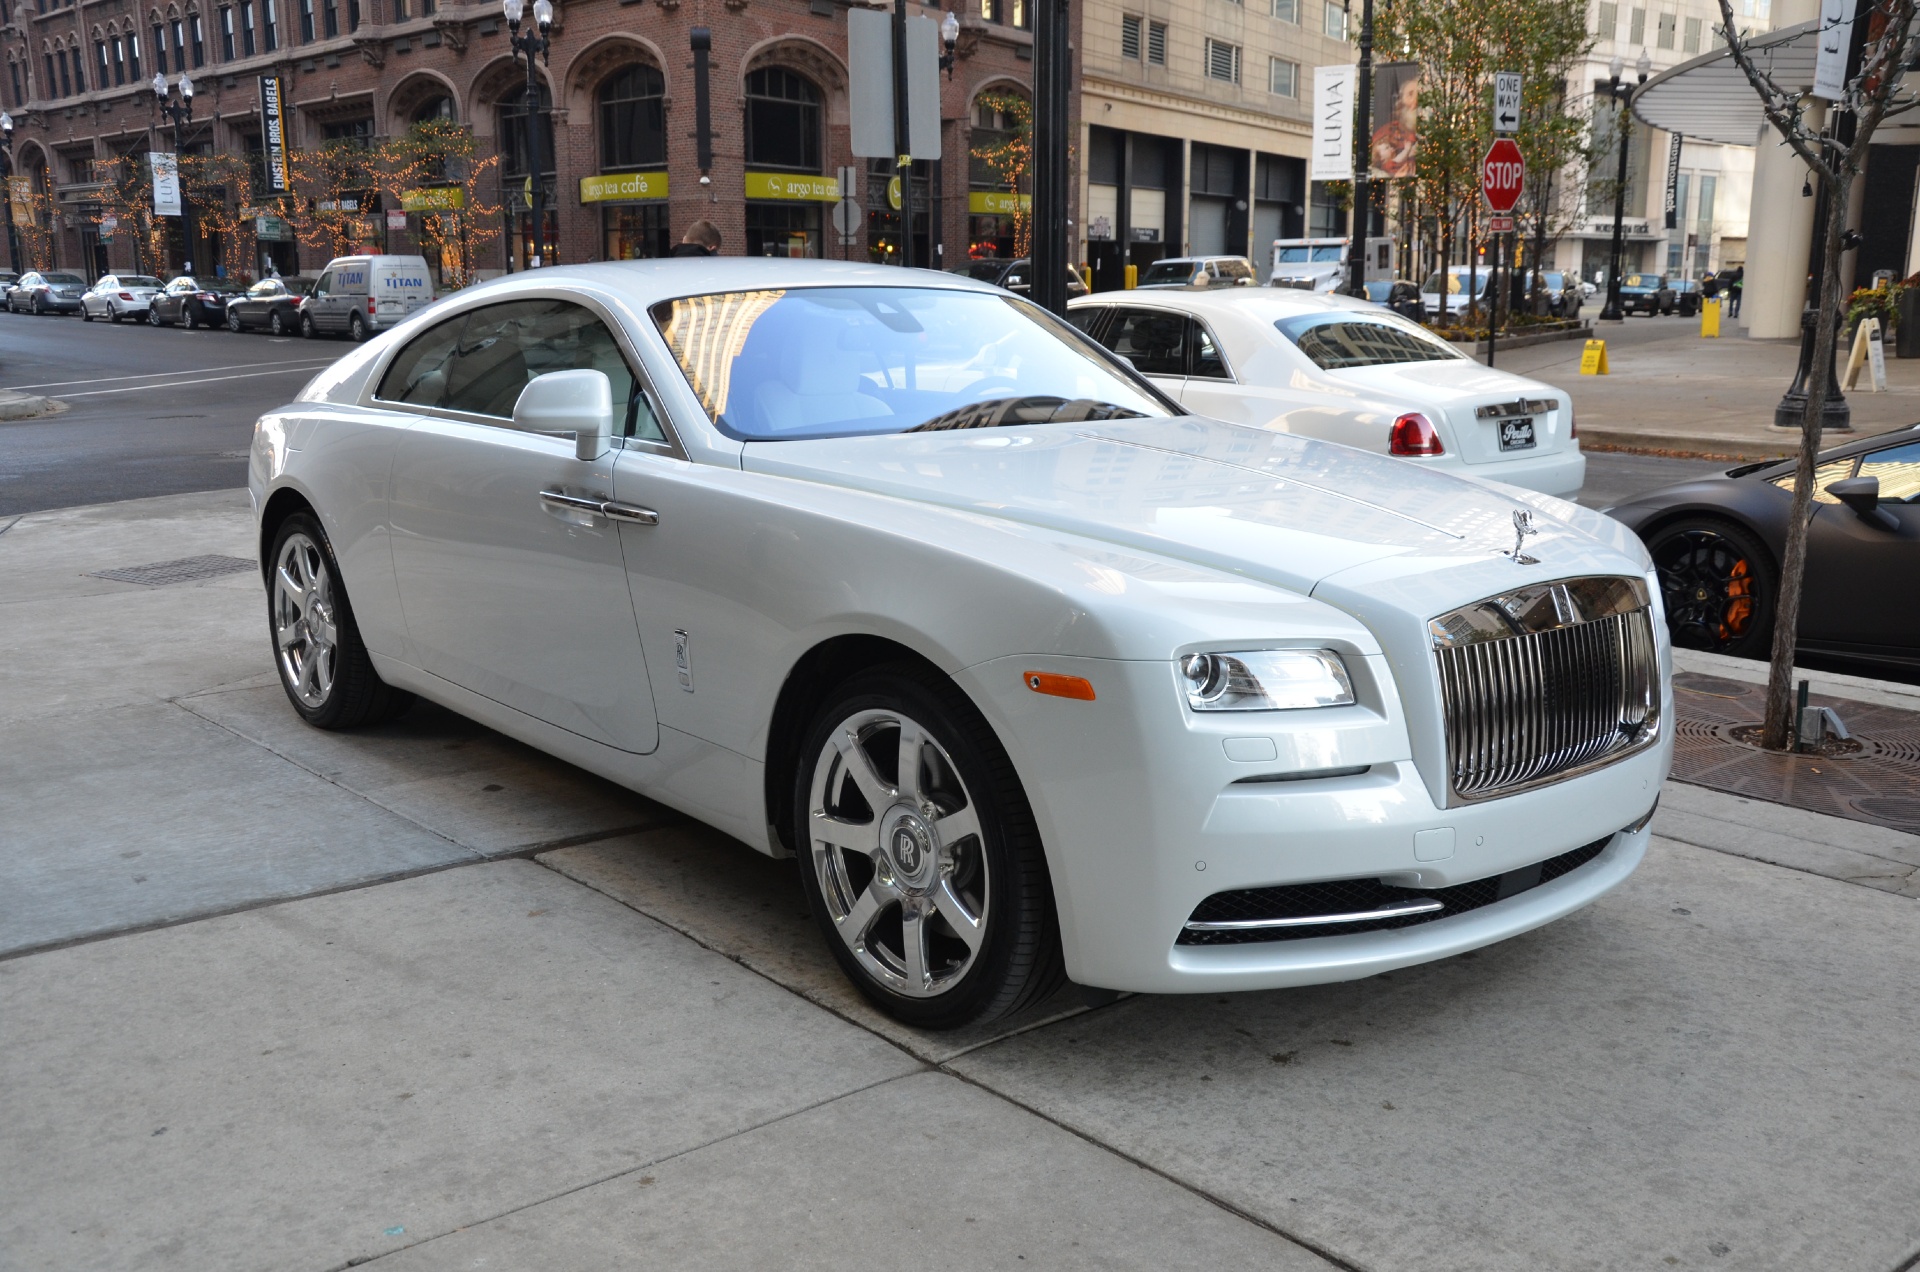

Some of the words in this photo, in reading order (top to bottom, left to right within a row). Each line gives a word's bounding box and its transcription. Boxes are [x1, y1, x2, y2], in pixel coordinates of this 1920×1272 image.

[1499, 78, 1519, 92] ONE
[265, 78, 277, 115] BAGELS
[1498, 95, 1519, 109] WAY
[1323, 80, 1344, 158] LUMA
[269, 118, 281, 144] BROS.
[271, 146, 284, 189] EINSTEIN
[1485, 162, 1522, 190] STOP
[589, 184, 604, 200] argo
[604, 182, 618, 195] tea
[621, 174, 649, 193] café
[786, 182, 811, 198] argo
[812, 182, 825, 196] tea
[341, 199, 358, 211] BAGELS
[1665, 188, 1677, 214] rack
[1492, 220, 1501, 229] ALL
[1502, 220, 1512, 229] WAY
[338, 272, 364, 288] TITAN
[384, 277, 423, 289] TITAN
